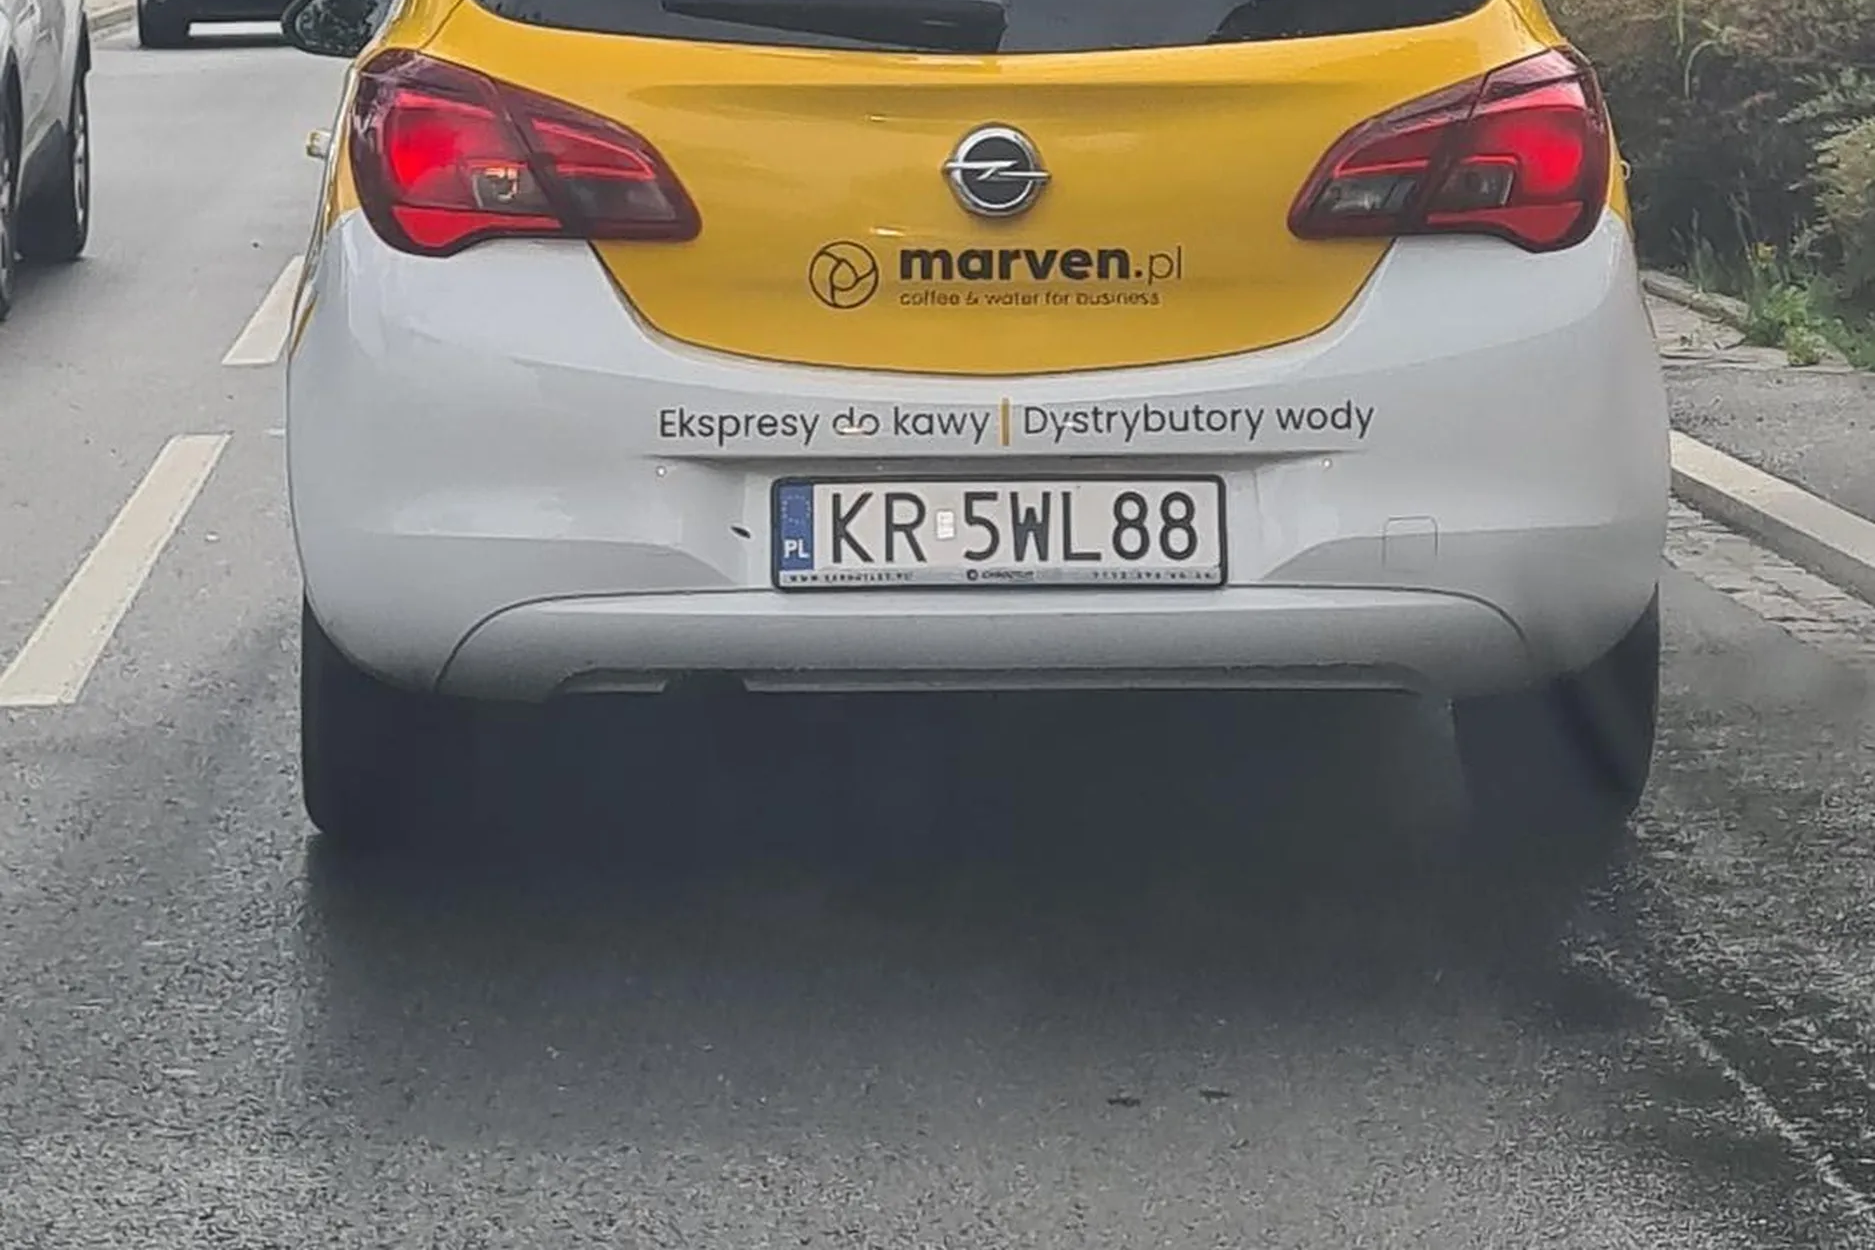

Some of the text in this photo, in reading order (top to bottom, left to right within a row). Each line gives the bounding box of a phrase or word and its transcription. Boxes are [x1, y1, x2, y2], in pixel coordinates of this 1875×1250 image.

[900, 246, 1182, 285] marven.pl
[900, 290, 1160, 306] coffee & water for business
[659, 399, 1375, 447] Ekspresy do kawy Dystrybutory wody
[831, 491, 1199, 563] KR 5WL88
[783, 540, 810, 558] PL
